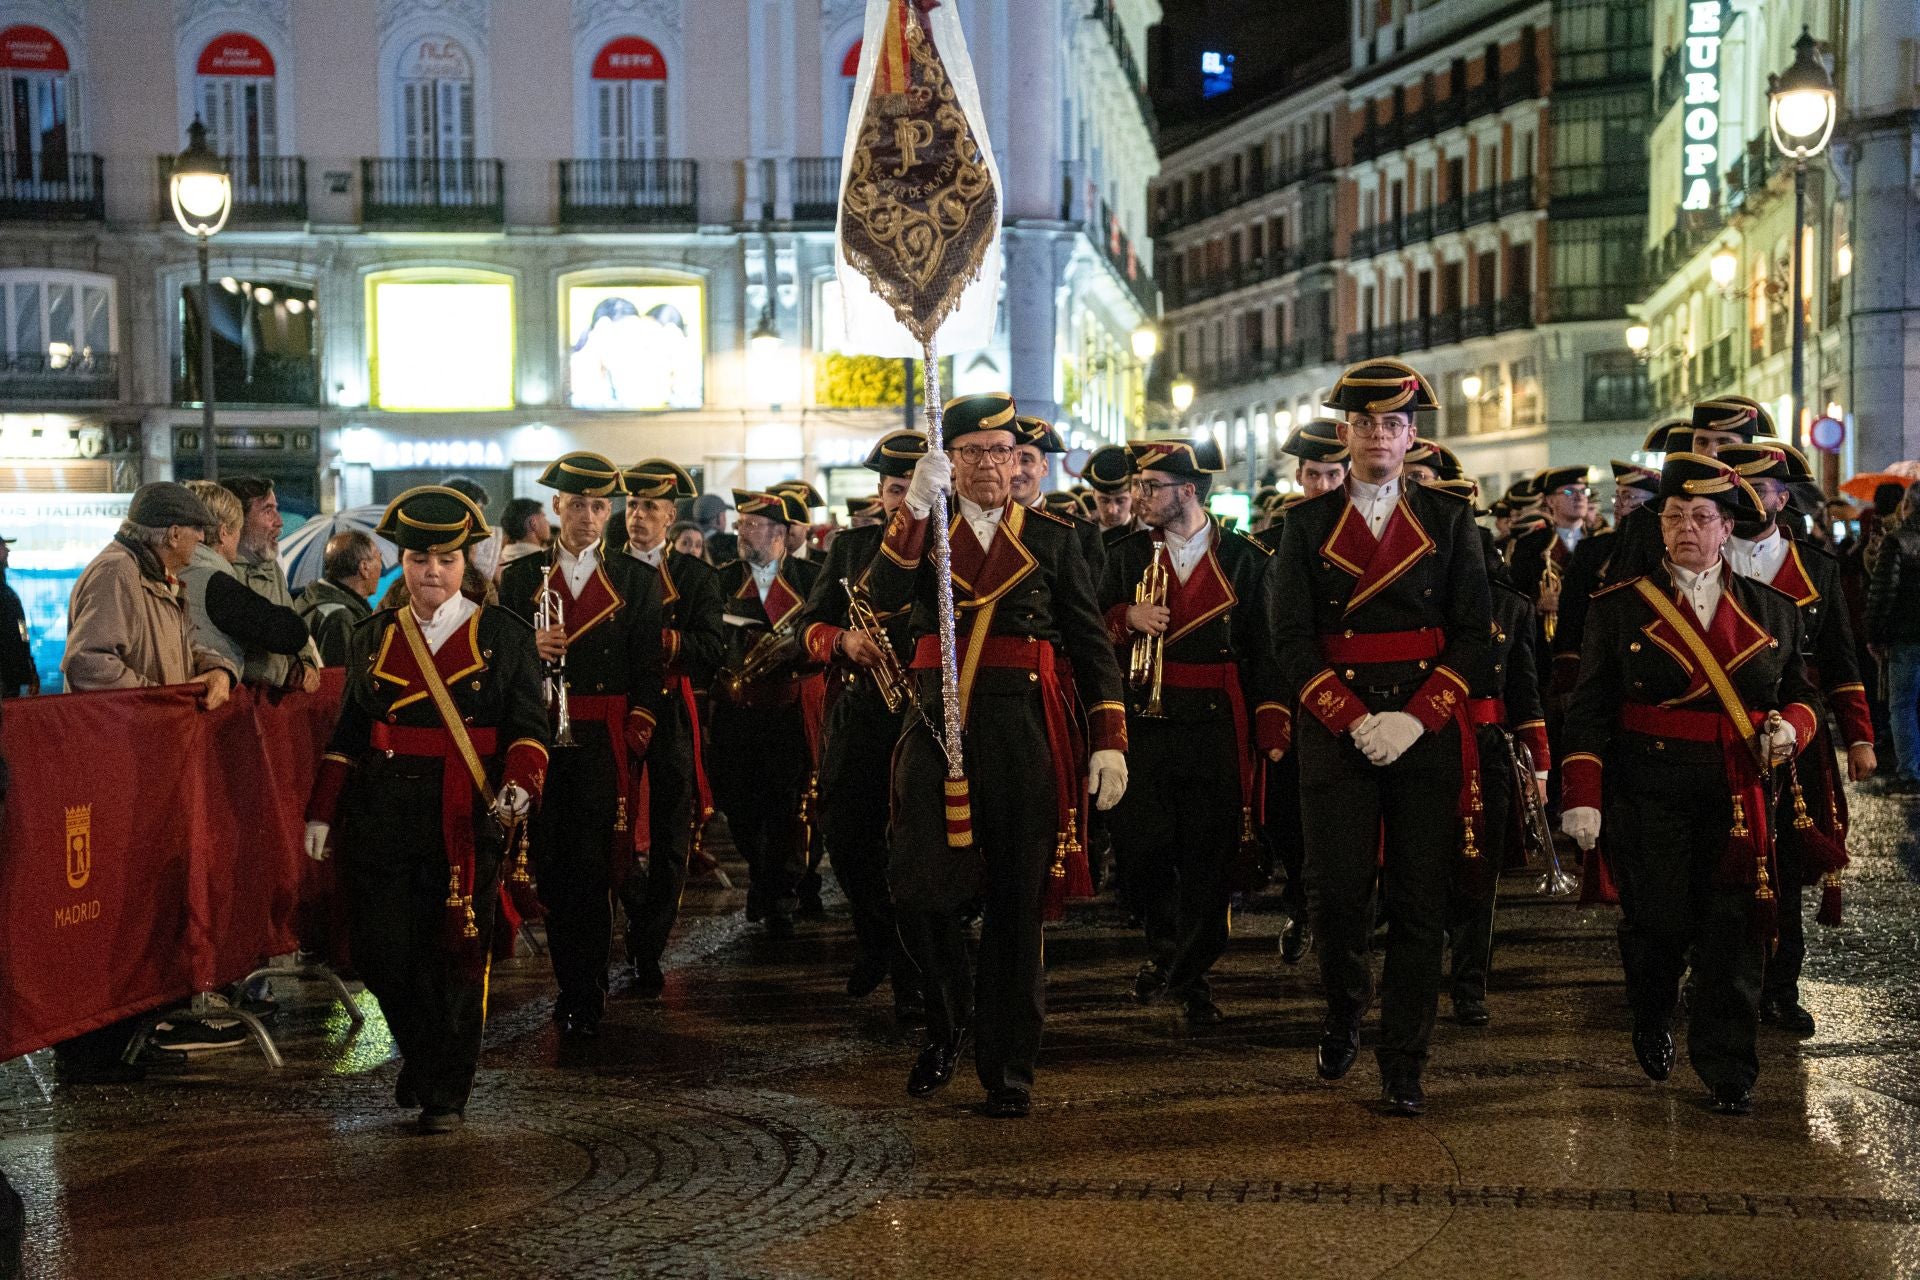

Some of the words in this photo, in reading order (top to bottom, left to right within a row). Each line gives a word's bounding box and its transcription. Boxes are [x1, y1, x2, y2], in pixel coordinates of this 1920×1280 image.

[1682, 1, 1722, 210] EUROPA
[908, 186, 922, 198] DE
[384, 441, 504, 466] SEPHORA
[55, 900, 101, 928] MADRID
